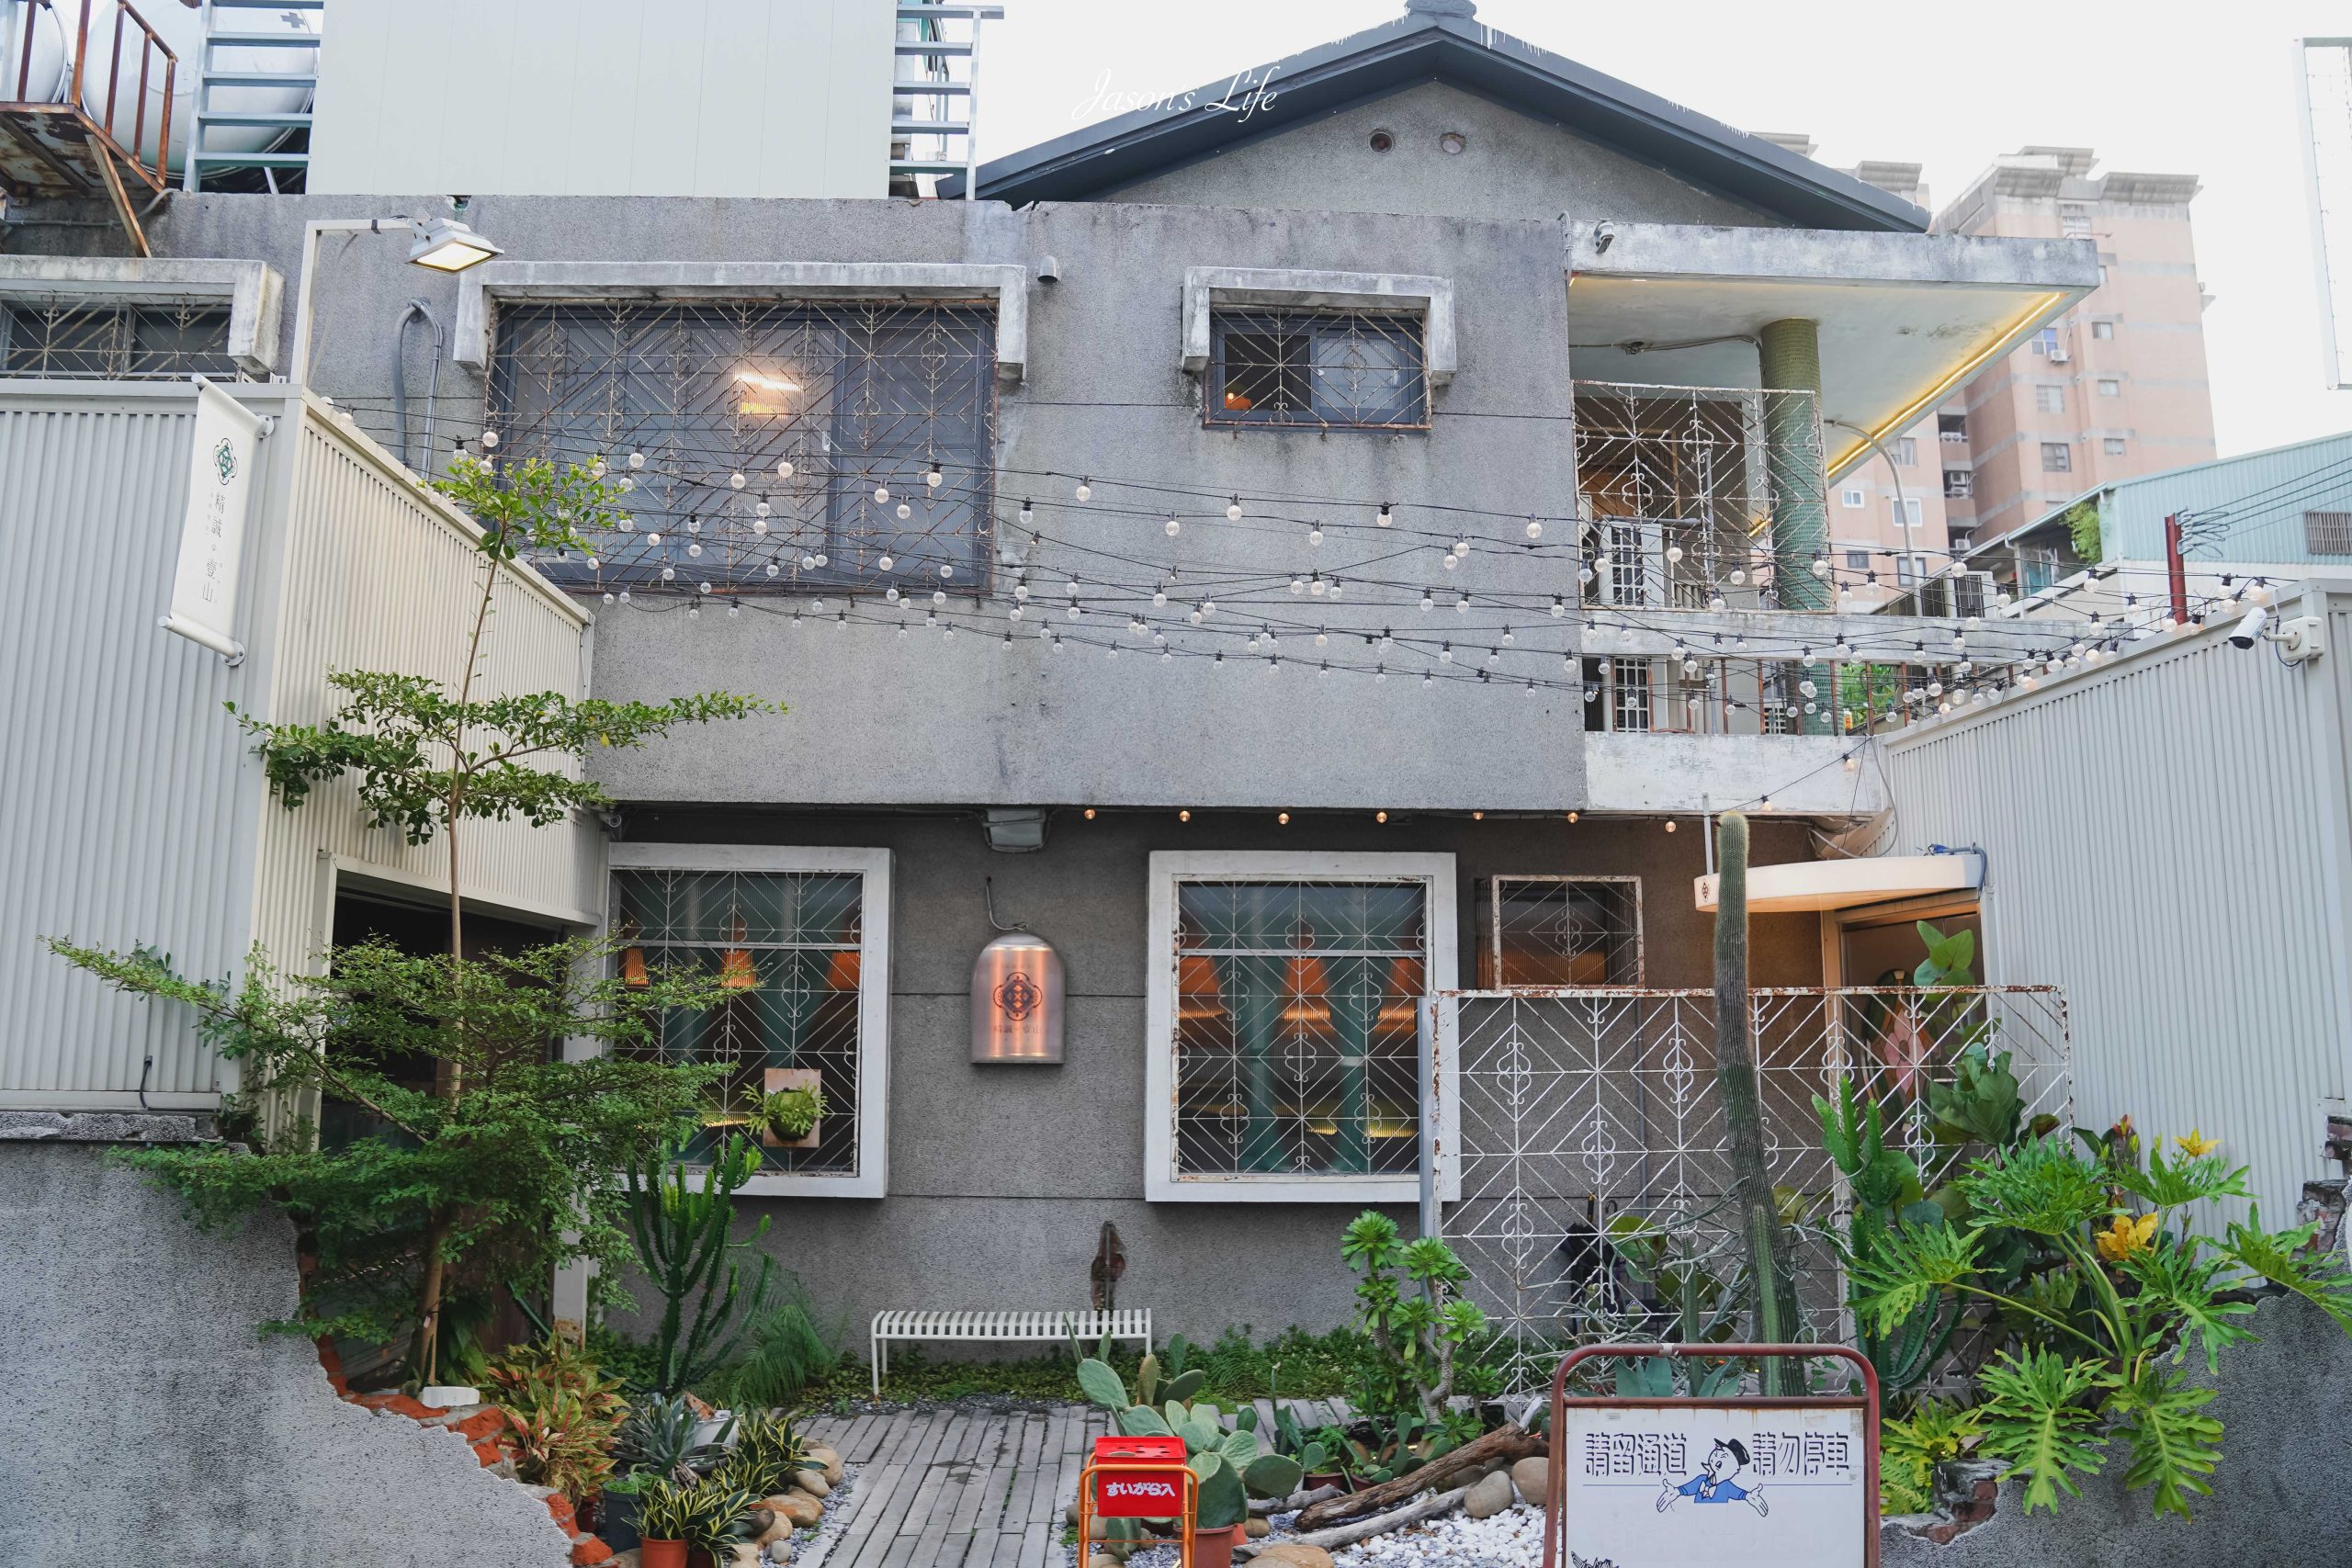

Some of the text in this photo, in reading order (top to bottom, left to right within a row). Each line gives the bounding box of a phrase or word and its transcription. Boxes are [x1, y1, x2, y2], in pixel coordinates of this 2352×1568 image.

[1585, 1432, 1687, 1476] 請留通道
[1752, 1432, 1849, 1475] 請勿停車
[1105, 1482, 1175, 1496] すいがら入
